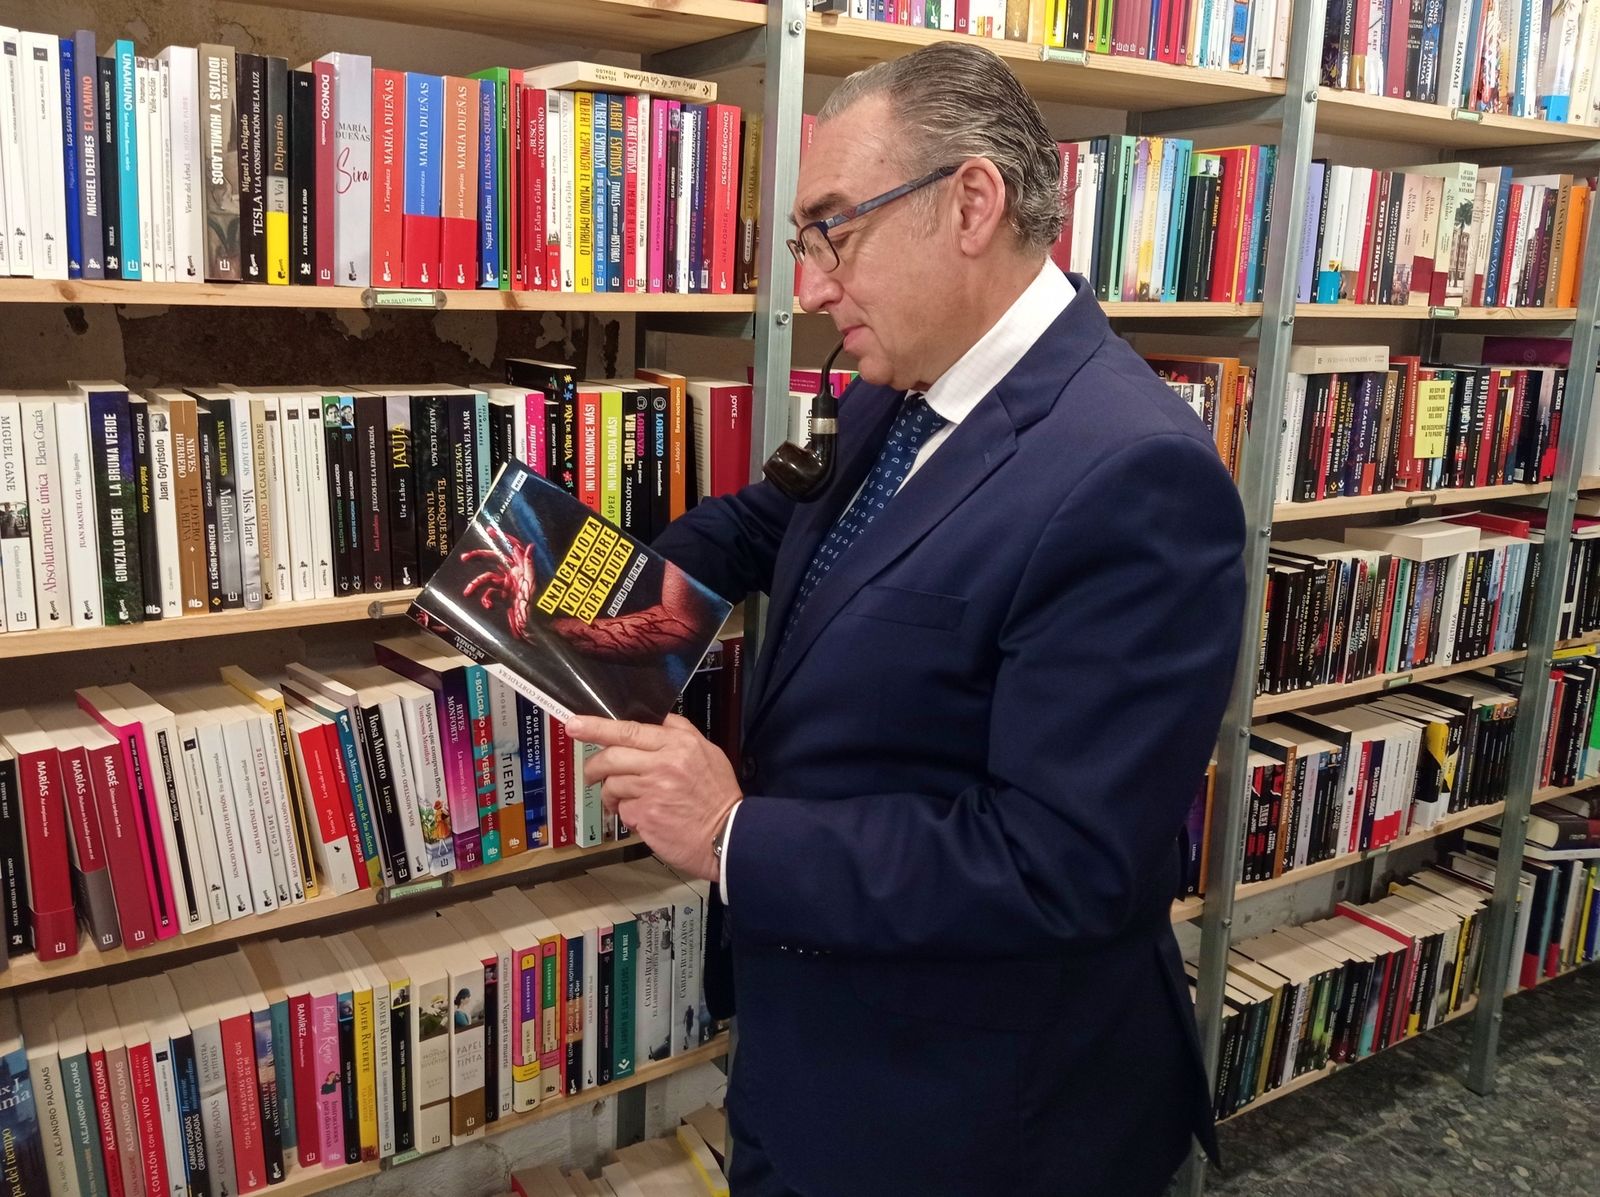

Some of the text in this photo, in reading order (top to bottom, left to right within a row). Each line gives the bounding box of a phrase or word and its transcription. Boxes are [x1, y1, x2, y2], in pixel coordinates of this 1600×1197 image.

[122, 54, 132, 111] UNAMUNO
[208, 57, 221, 100] IDIOTAS
[1451, 41, 1464, 89] HANNAH
[83, 76, 94, 131] EL CAMINO
[253, 91, 259, 102] LA
[254, 103, 260, 113] DE
[321, 75, 329, 119] DONOSO
[383, 80, 393, 165] MARÍA DUEÑAS
[210, 114, 224, 184] HUMILLADOS
[252, 115, 261, 175] CONSPIRACIÓN
[273, 115, 285, 171] Delparaíso
[418, 82, 428, 167] MARÍA DUEÑAS
[455, 86, 466, 170] MARÍA DUEÑAS
[580, 98, 589, 170] ALBERT ESPINOSA
[595, 101, 606, 168] ALBERT ESPINOSA
[611, 102, 622, 176] ALBERT ESPINOSA
[627, 117, 637, 173] ALBERT ESPINOSA
[85, 135, 97, 216] MIGUEL DELIBES
[241, 114, 250, 192] Miguel A. Delgado
[255, 176, 261, 187] LA
[1322, 200, 1327, 209] DE
[253, 195, 263, 235] TESLA
[580, 174, 590, 256] EL MUNDO AMARILLO
[1391, 201, 1400, 236] ESCALONES
[1495, 199, 1506, 244] CABEZA
[1373, 270, 1377, 281] EL
[1377, 230, 1382, 242] DE
[1488, 258, 1496, 288] VACA
[626, 414, 636, 432] IRA
[730, 395, 738, 417] JOYCE
[1360, 409, 1368, 448] CASTILLO
[1460, 376, 1474, 433] LA GRAN MENTIRA
[1475, 375, 1490, 430] LA PSICÓLOGA
[33, 410, 47, 466] Elena García
[105, 413, 122, 496] LA BRUMA VERDE
[176, 433, 185, 478] HERRERO
[187, 438, 195, 472] NIEVES
[256, 423, 267, 499] LA CASA DEL PADRE
[392, 423, 410, 469] JAUJA
[528, 425, 538, 467] Valentina
[583, 404, 595, 491] ¡NI UN ROMANCE MÁS!
[606, 417, 617, 491] ¡NI UNA BODA MÁS!
[656, 414, 664, 456] LORENZO
[157, 440, 169, 500] Juan Goytisolo
[219, 488, 233, 542] Malaherba
[243, 489, 255, 546] Miss Marte
[499, 492, 515, 515] APACHE
[38, 473, 58, 594] Absolutamente única
[111, 508, 127, 582] GONZALO GINER
[208, 525, 217, 557] MANTECA
[210, 558, 218, 579] SEÑOR
[540, 520, 600, 611] UNA GAVIOTA
[561, 529, 617, 615] VOLÓ SOBRE
[578, 541, 632, 623] CORTADURA
[624, 578, 632, 591] DE
[630, 554, 647, 581] ROMEU
[448, 696, 459, 743] MONFORTE
[457, 704, 465, 730] REYES
[475, 679, 485, 727] BOLÍGRAFO
[369, 715, 386, 779] Rosa Montero
[527, 737, 532, 747] EL
[37, 761, 49, 795] MARÍAS
[72, 759, 86, 794] MARÍAS
[104, 756, 119, 785] MARSÉ
[256, 748, 271, 804] RISTO MEJIDE
[480, 756, 490, 785] VERDE
[268, 815, 280, 856] EL CHISME
[644, 977, 652, 1007] CARLOS
[297, 1004, 306, 1037] RAMÍREZ
[360, 1001, 371, 1073] JAVIER REVERTE
[379, 995, 388, 1065] JAVIER REVERTE
[142, 1056, 151, 1087] PERIDIS
[42, 1067, 63, 1156] ALEJANDRO PALOMAS
[71, 1062, 89, 1144] ALEJANDRO PALOMAS
[95, 1060, 115, 1150] ALEJANDRO PALOMAS
[116, 1062, 135, 1152] ALEJANDRO PALOMAS
[142, 1097, 151, 1118] VIVO
[2, 1128, 20, 1182] del tiempo
[211, 1100, 227, 1174] CARMEN POSADAS
[148, 1151, 161, 1192] CORAZÓN
